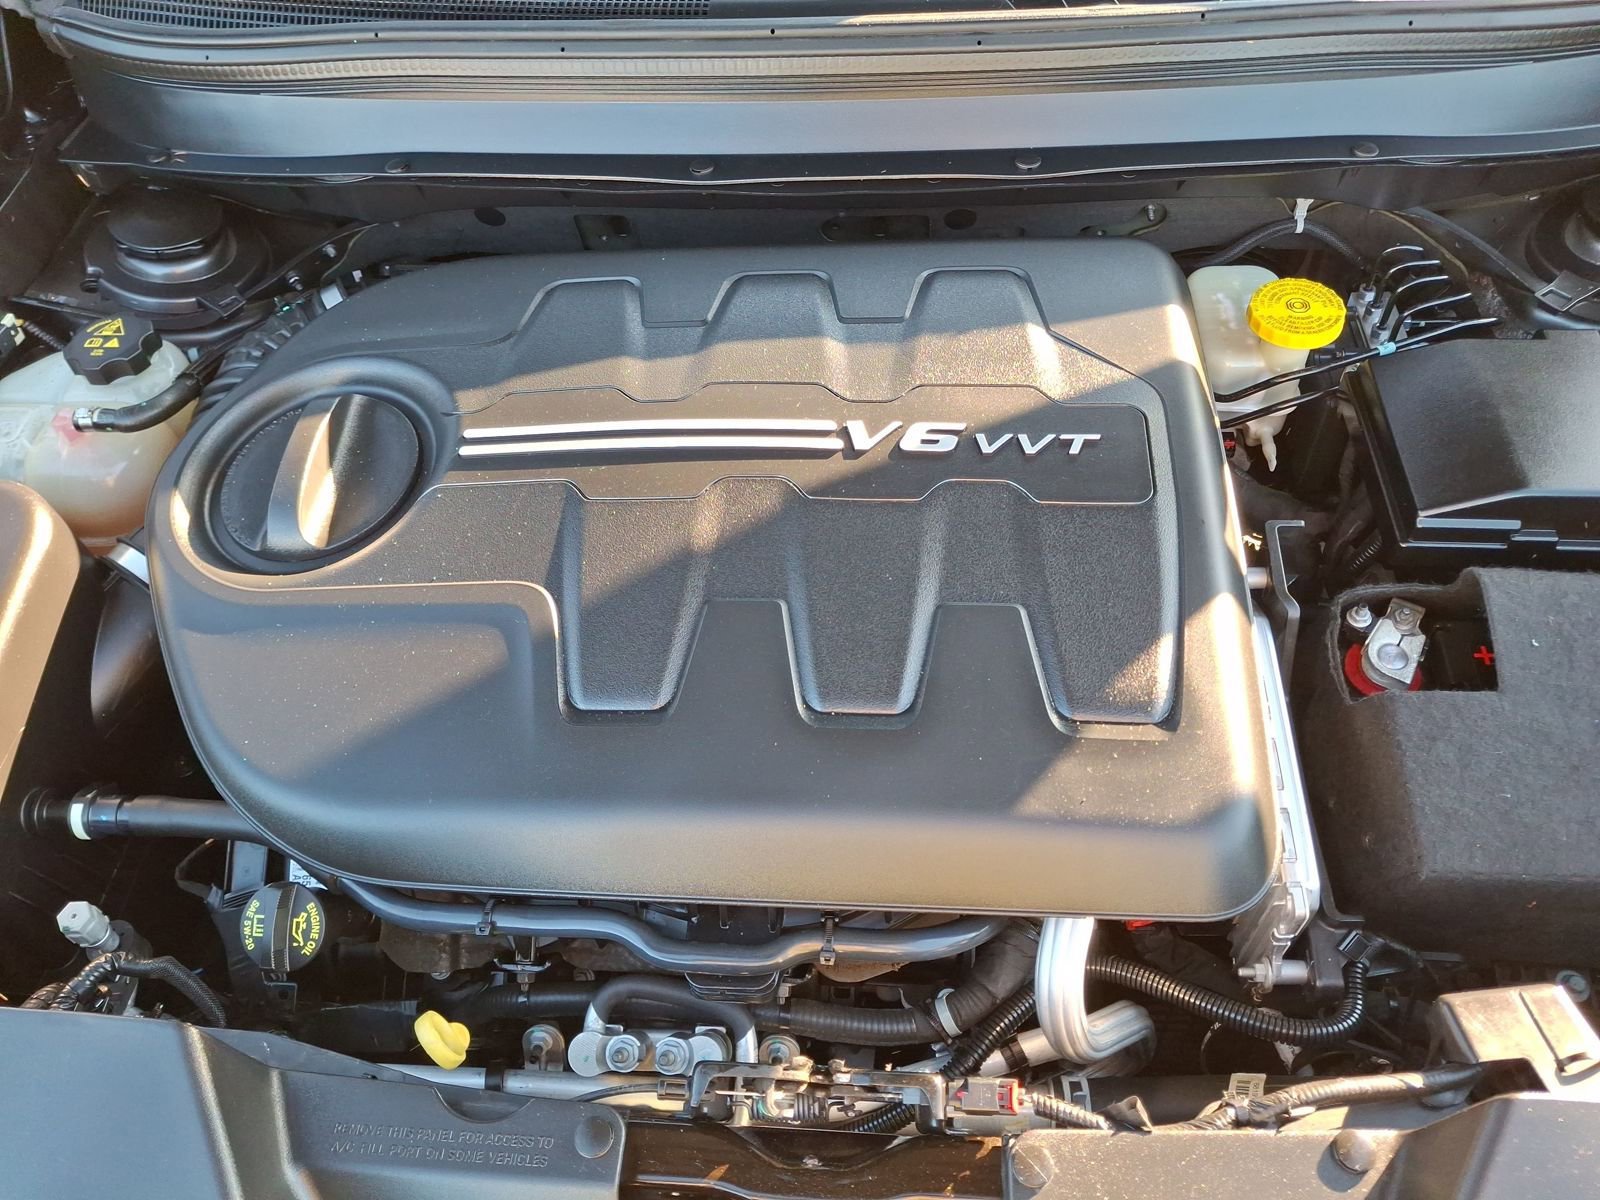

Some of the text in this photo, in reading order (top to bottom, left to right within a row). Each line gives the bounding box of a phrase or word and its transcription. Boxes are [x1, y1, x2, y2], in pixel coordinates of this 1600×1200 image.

[845, 420, 1102, 455] V6 VVT
[243, 899, 260, 951] SAE 5W-20
[301, 902, 321, 956] ENGINE OIL
[334, 1122, 554, 1149] REMOVE THIS PANEL FOR ACCESS TO
[331, 1140, 549, 1167] A/C FILL PORT ON SOME VEHICLES
